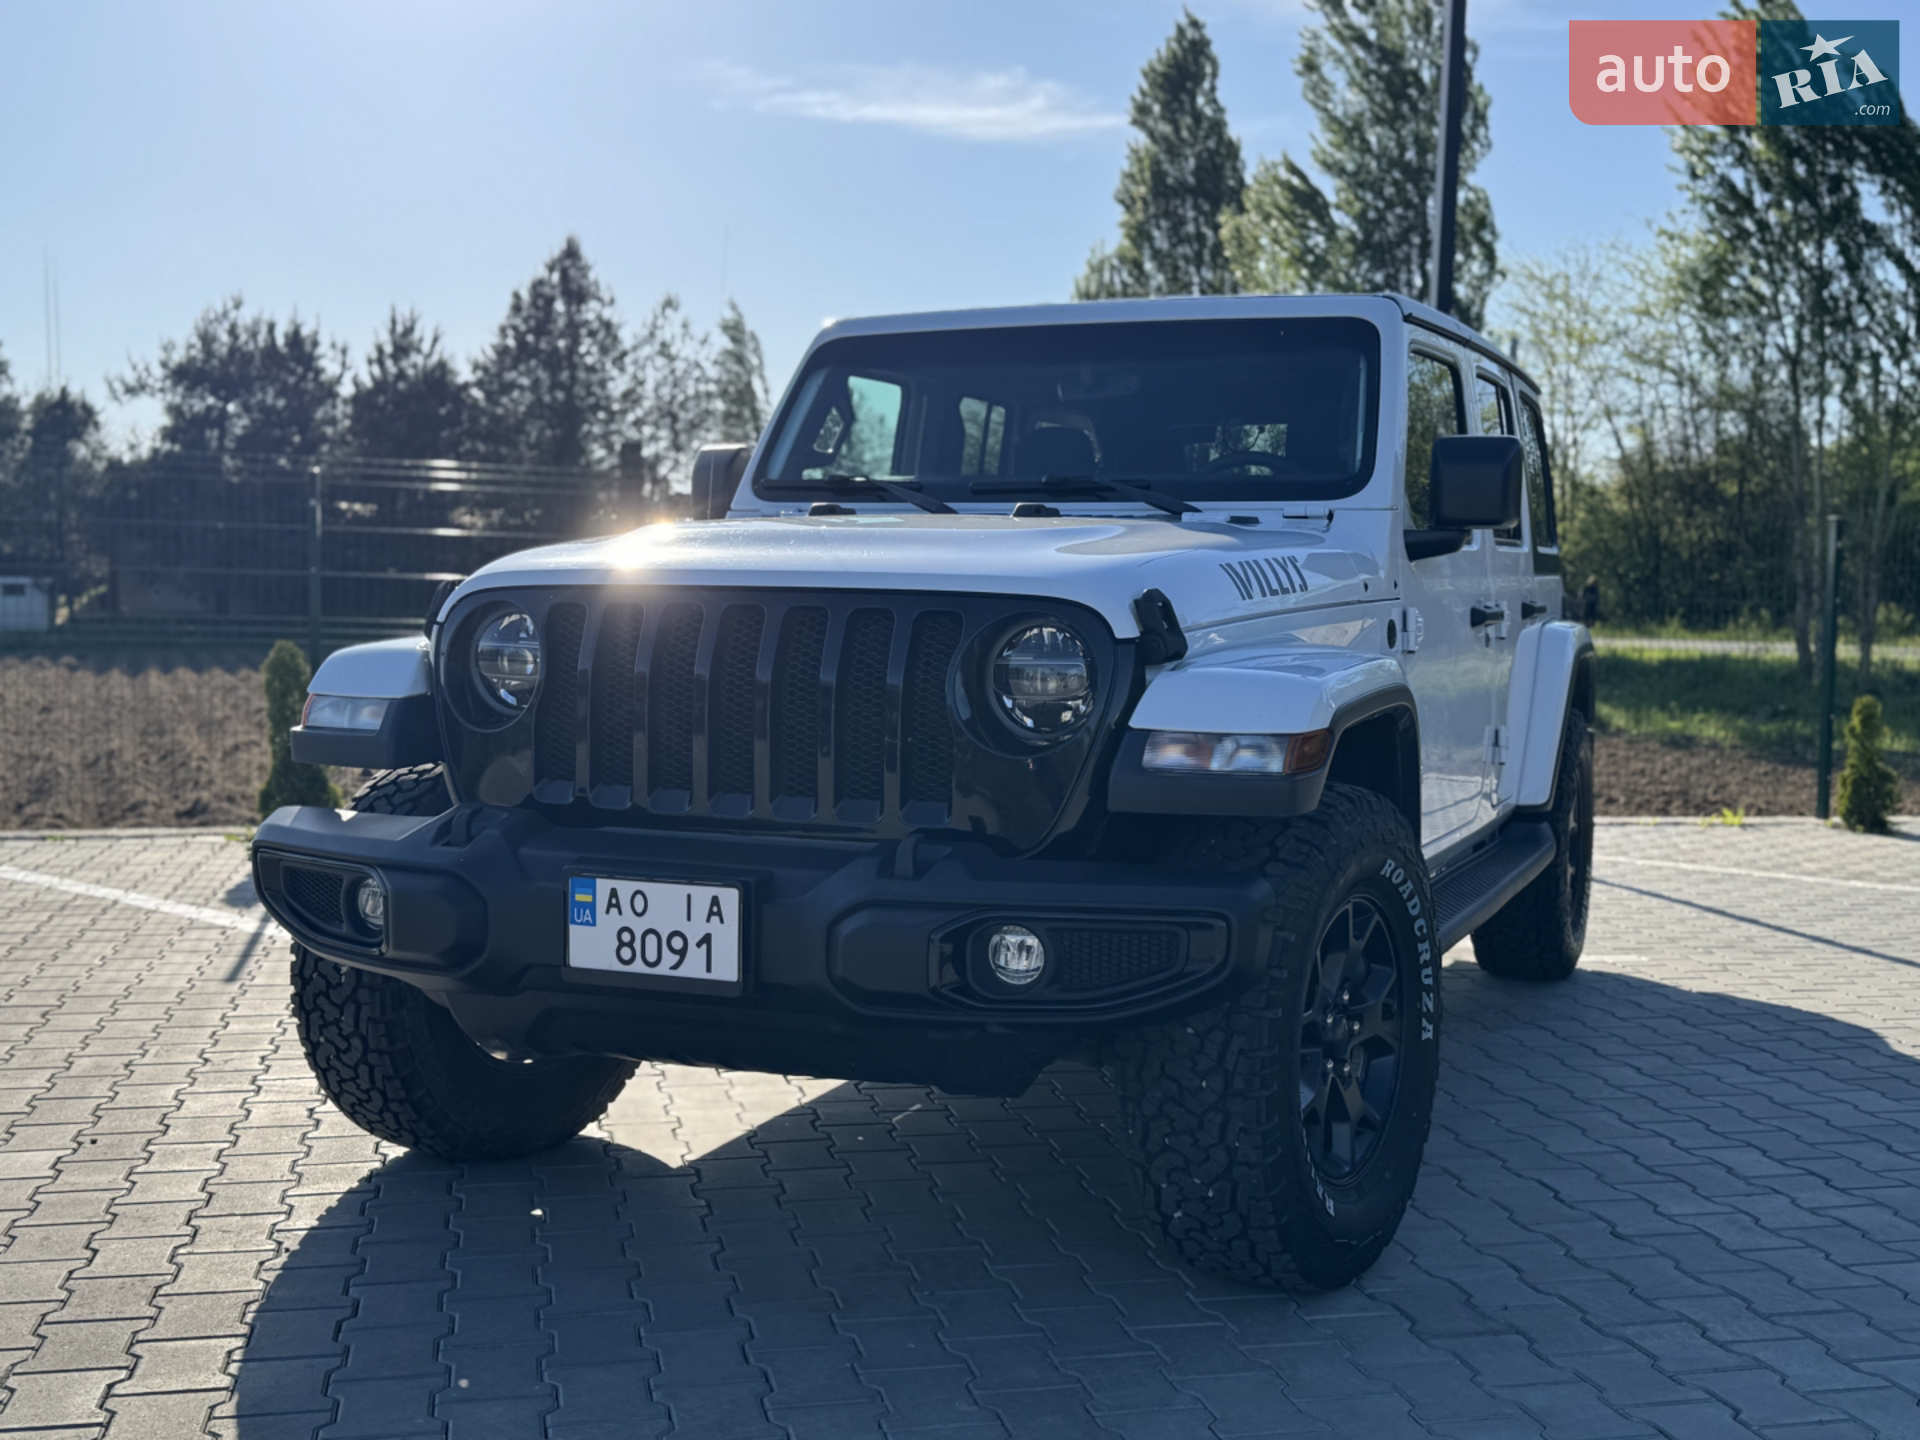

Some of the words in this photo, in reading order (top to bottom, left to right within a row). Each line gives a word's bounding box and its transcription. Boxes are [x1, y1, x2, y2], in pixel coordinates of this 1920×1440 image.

[1218, 555, 1309, 601] WILLYS
[573, 907, 593, 924] UA
[605, 887, 649, 918] AO
[686, 893, 725, 925] IA
[615, 926, 713, 974] 8091
[1379, 858, 1434, 1041] ROADCRUZA
